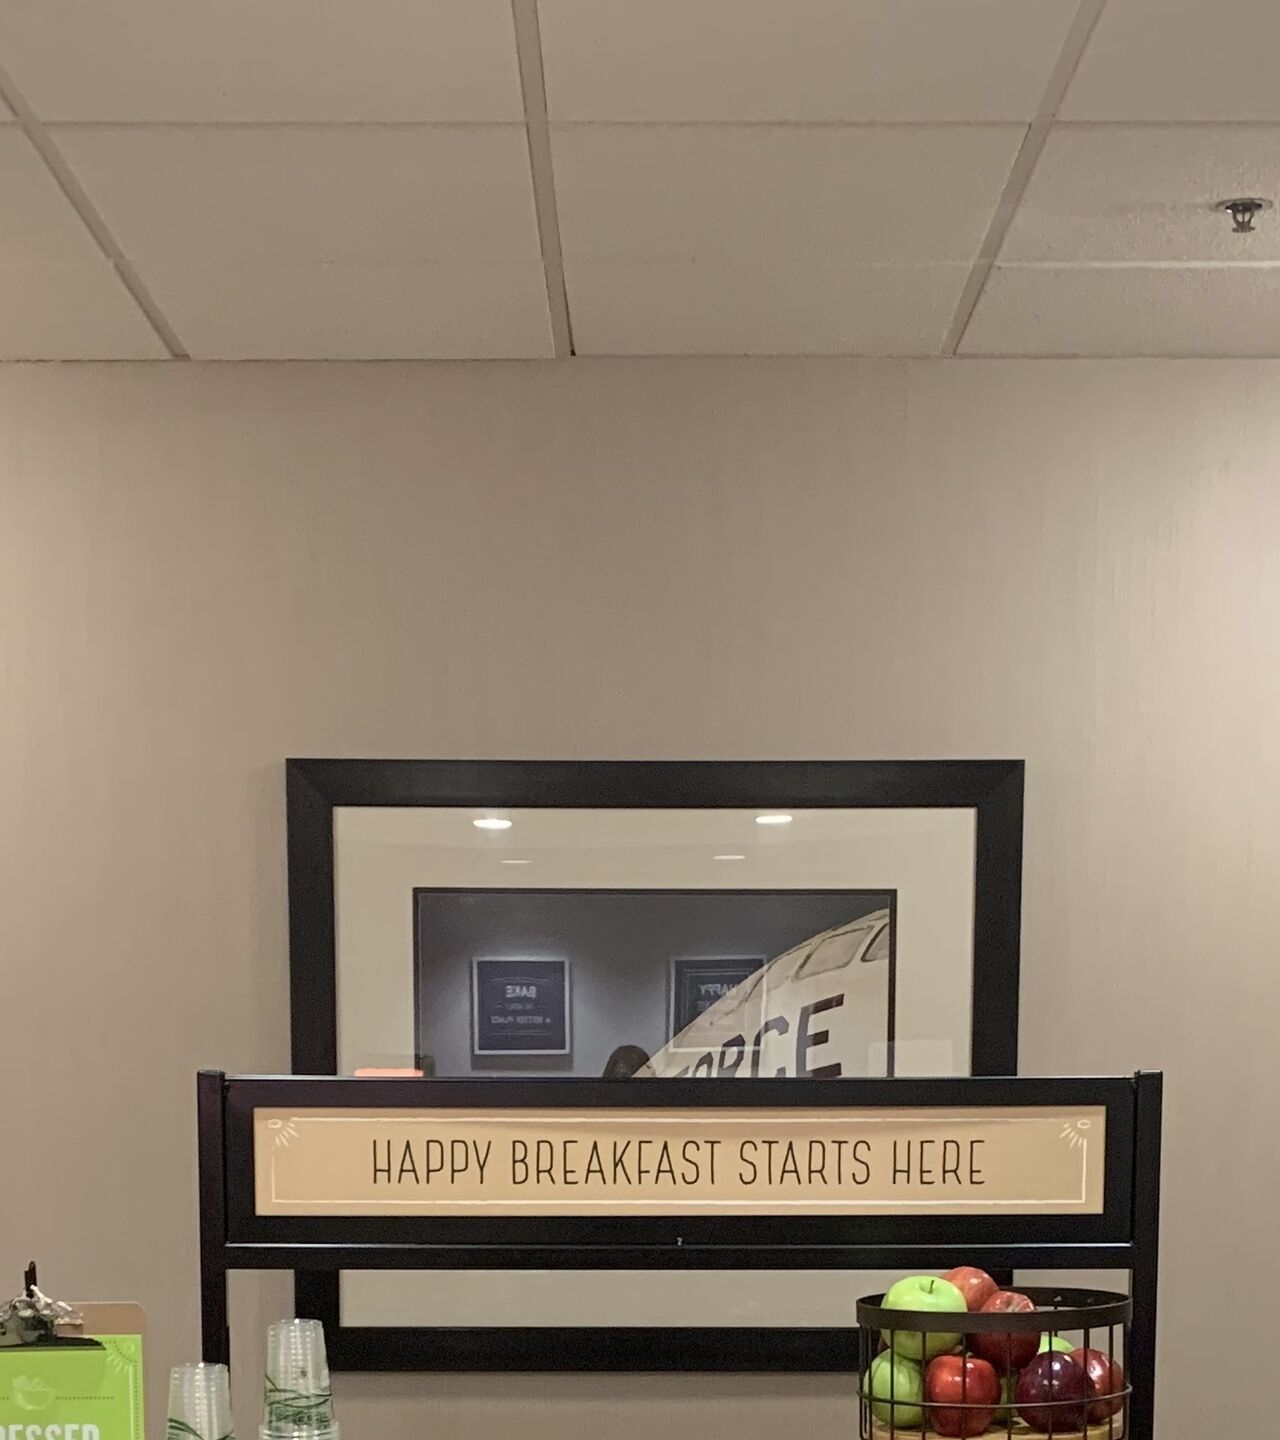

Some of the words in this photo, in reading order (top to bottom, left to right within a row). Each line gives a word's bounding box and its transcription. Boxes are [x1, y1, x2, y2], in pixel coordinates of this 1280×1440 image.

[371, 1138, 493, 1186] HAPPY
[511, 1138, 723, 1186] BREAKFAST
[737, 1138, 872, 1186] STARTS
[891, 1138, 986, 1186] HERE
